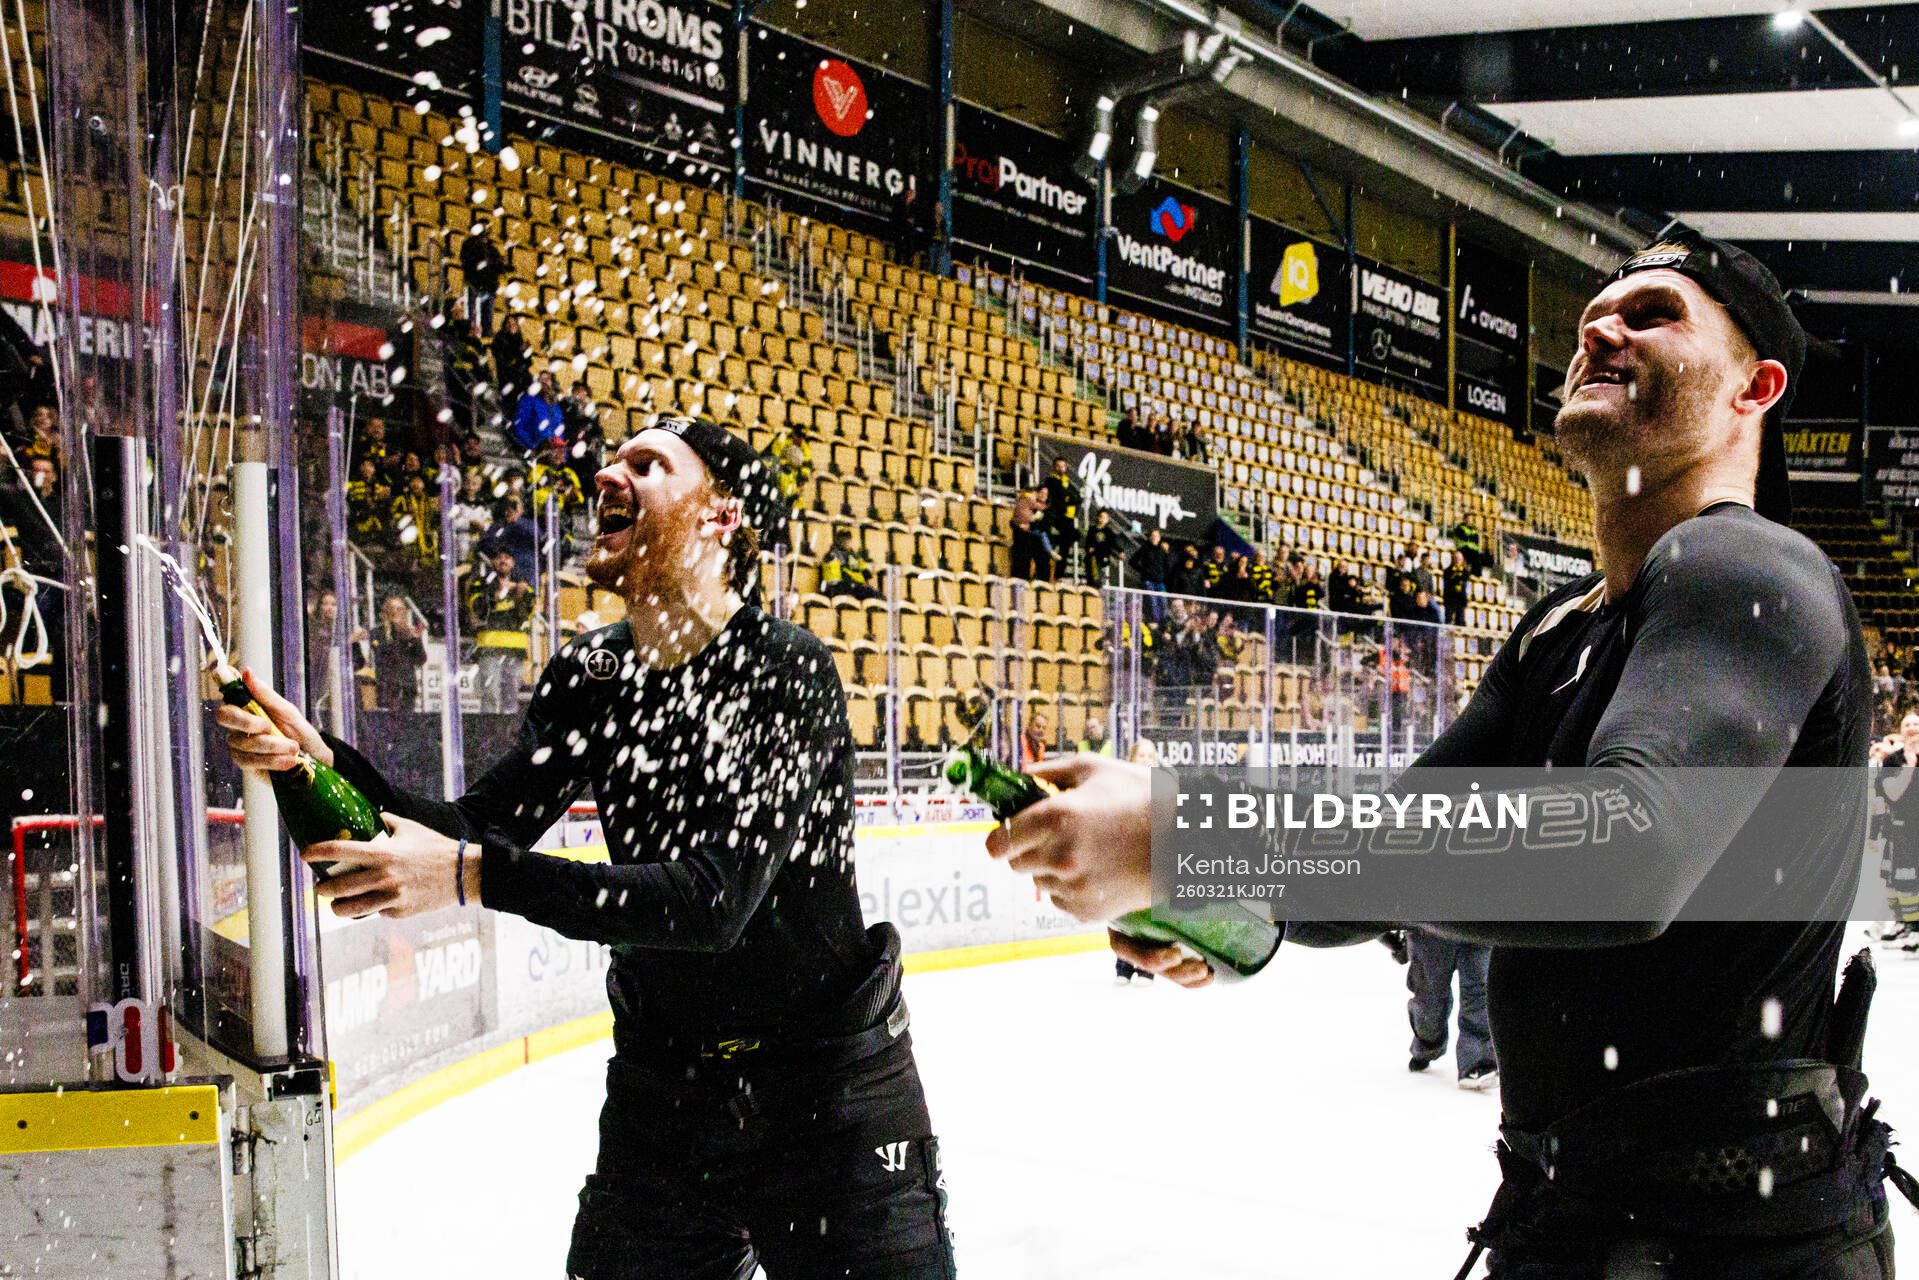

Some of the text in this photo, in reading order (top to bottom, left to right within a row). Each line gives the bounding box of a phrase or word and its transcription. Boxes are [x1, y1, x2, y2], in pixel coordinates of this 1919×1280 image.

[506, 0, 619, 67] BILAR
[1117, 234, 1226, 291] VentPartner
[1288, 255, 1310, 292] IQ
[1361, 269, 1414, 312] VEHO
[1412, 291, 1441, 324] BIL
[1467, 384, 1506, 414] LOGEN
[415, 938, 482, 1000] YARD
